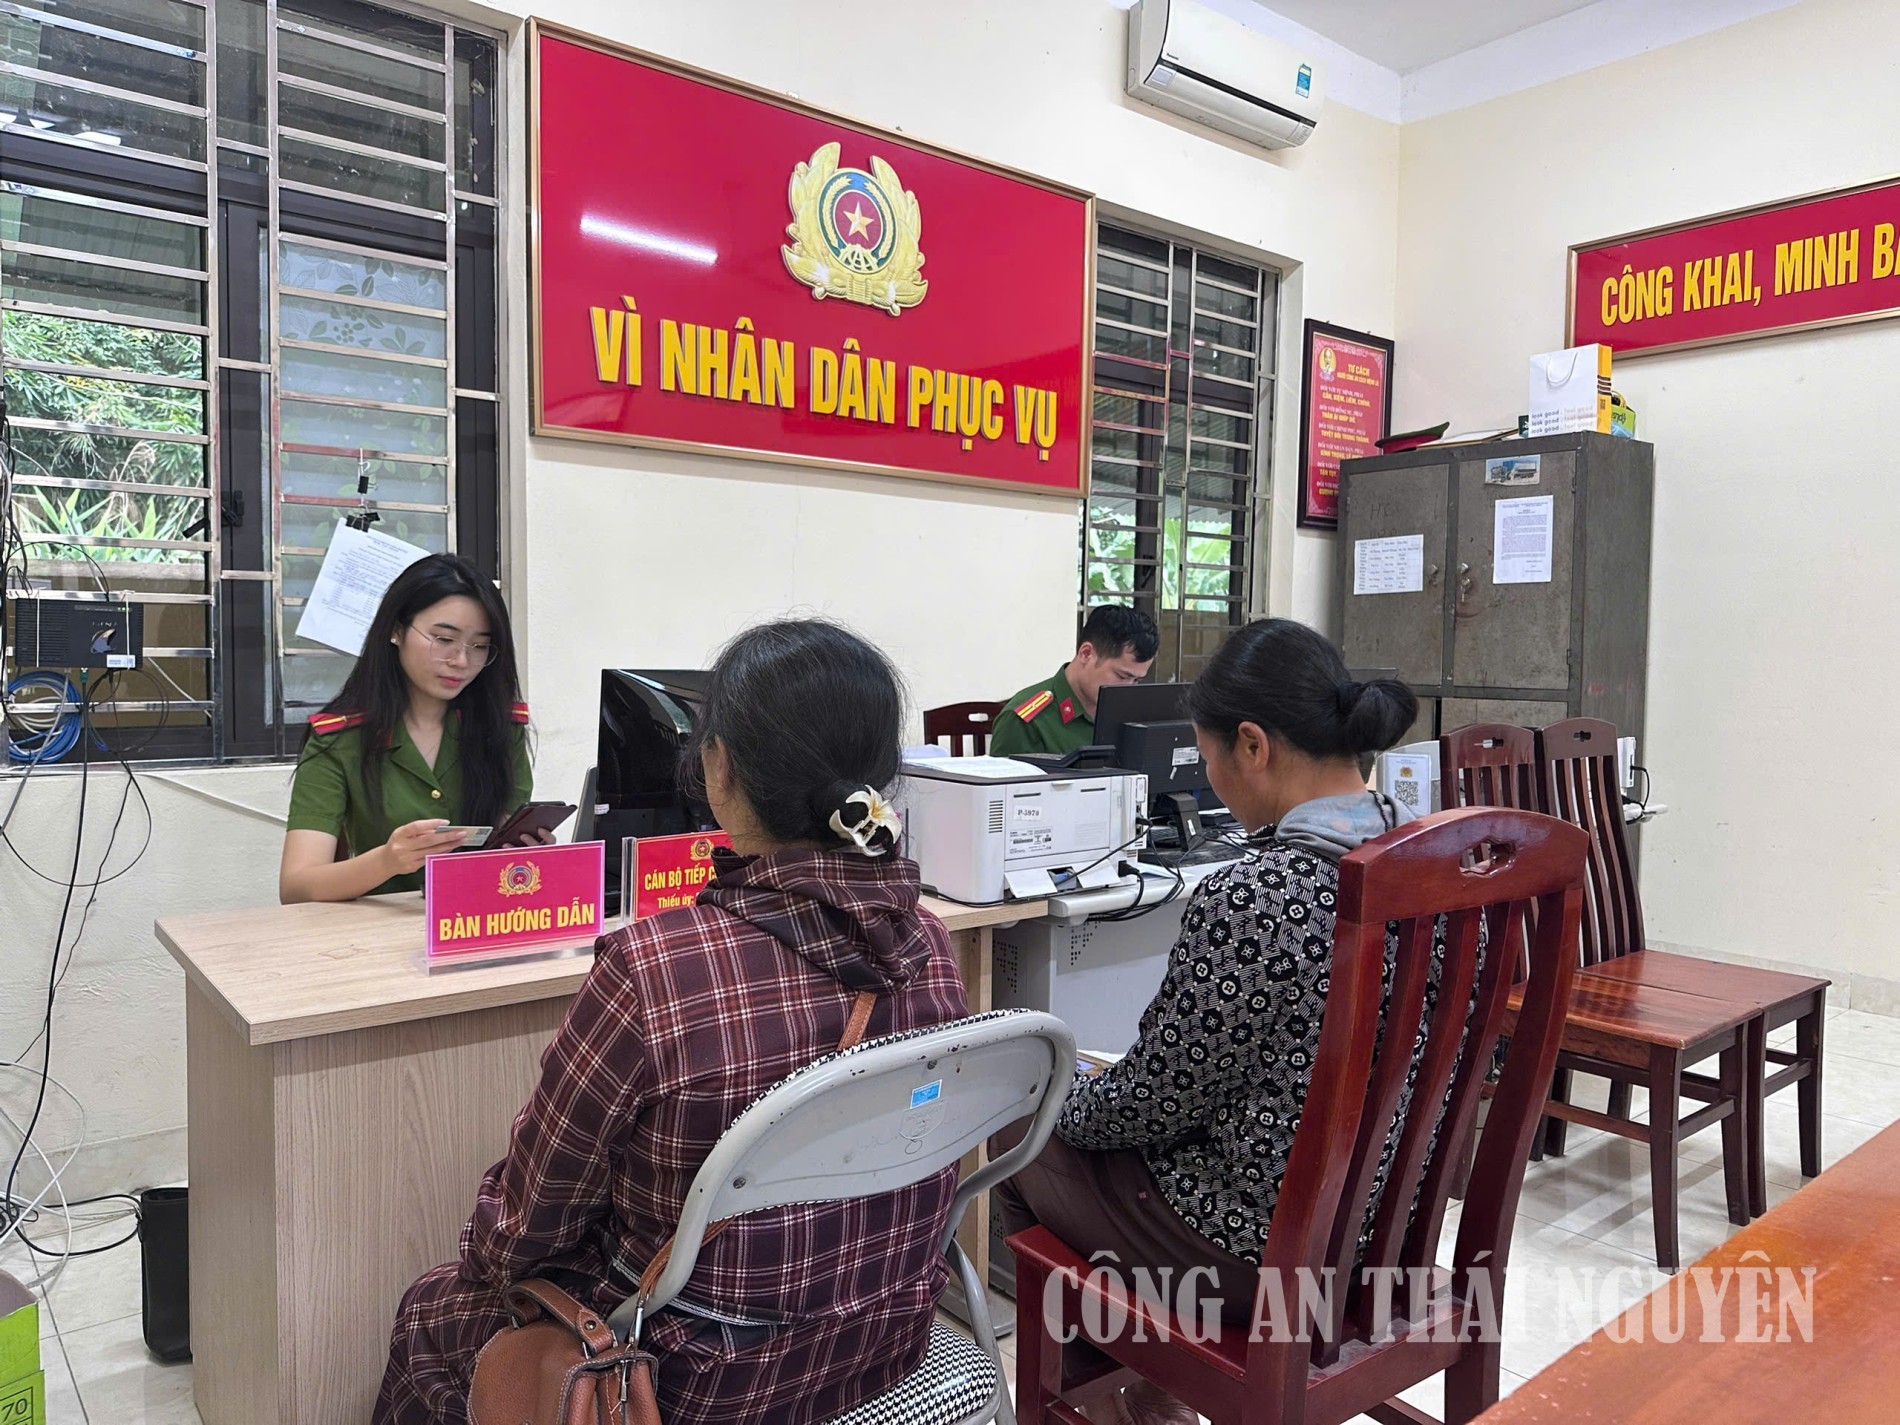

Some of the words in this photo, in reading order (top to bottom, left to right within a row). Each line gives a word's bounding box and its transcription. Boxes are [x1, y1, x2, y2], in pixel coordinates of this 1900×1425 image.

[1601, 264, 1673, 327] CÔNG
[1682, 249, 1762, 313] KHAI,
[1774, 228, 1860, 297] MINH
[1872, 222, 1900, 280] B
[590, 295, 642, 387] VÌ
[659, 316, 796, 409] NHÂN
[810, 336, 895, 424] DÂN
[907, 364, 1004, 451] PHỤC
[1015, 384, 1058, 462] VỤ
[644, 868, 666, 891] CÁN
[668, 866, 682, 890] BỘ
[684, 862, 706, 886] TIẾP
[439, 911, 480, 941] BÀN
[487, 904, 551, 936] HƯỚNG
[557, 896, 595, 928] DẪN
[657, 892, 680, 909] Thiếu
[2, 1398, 28, 1422] 70
